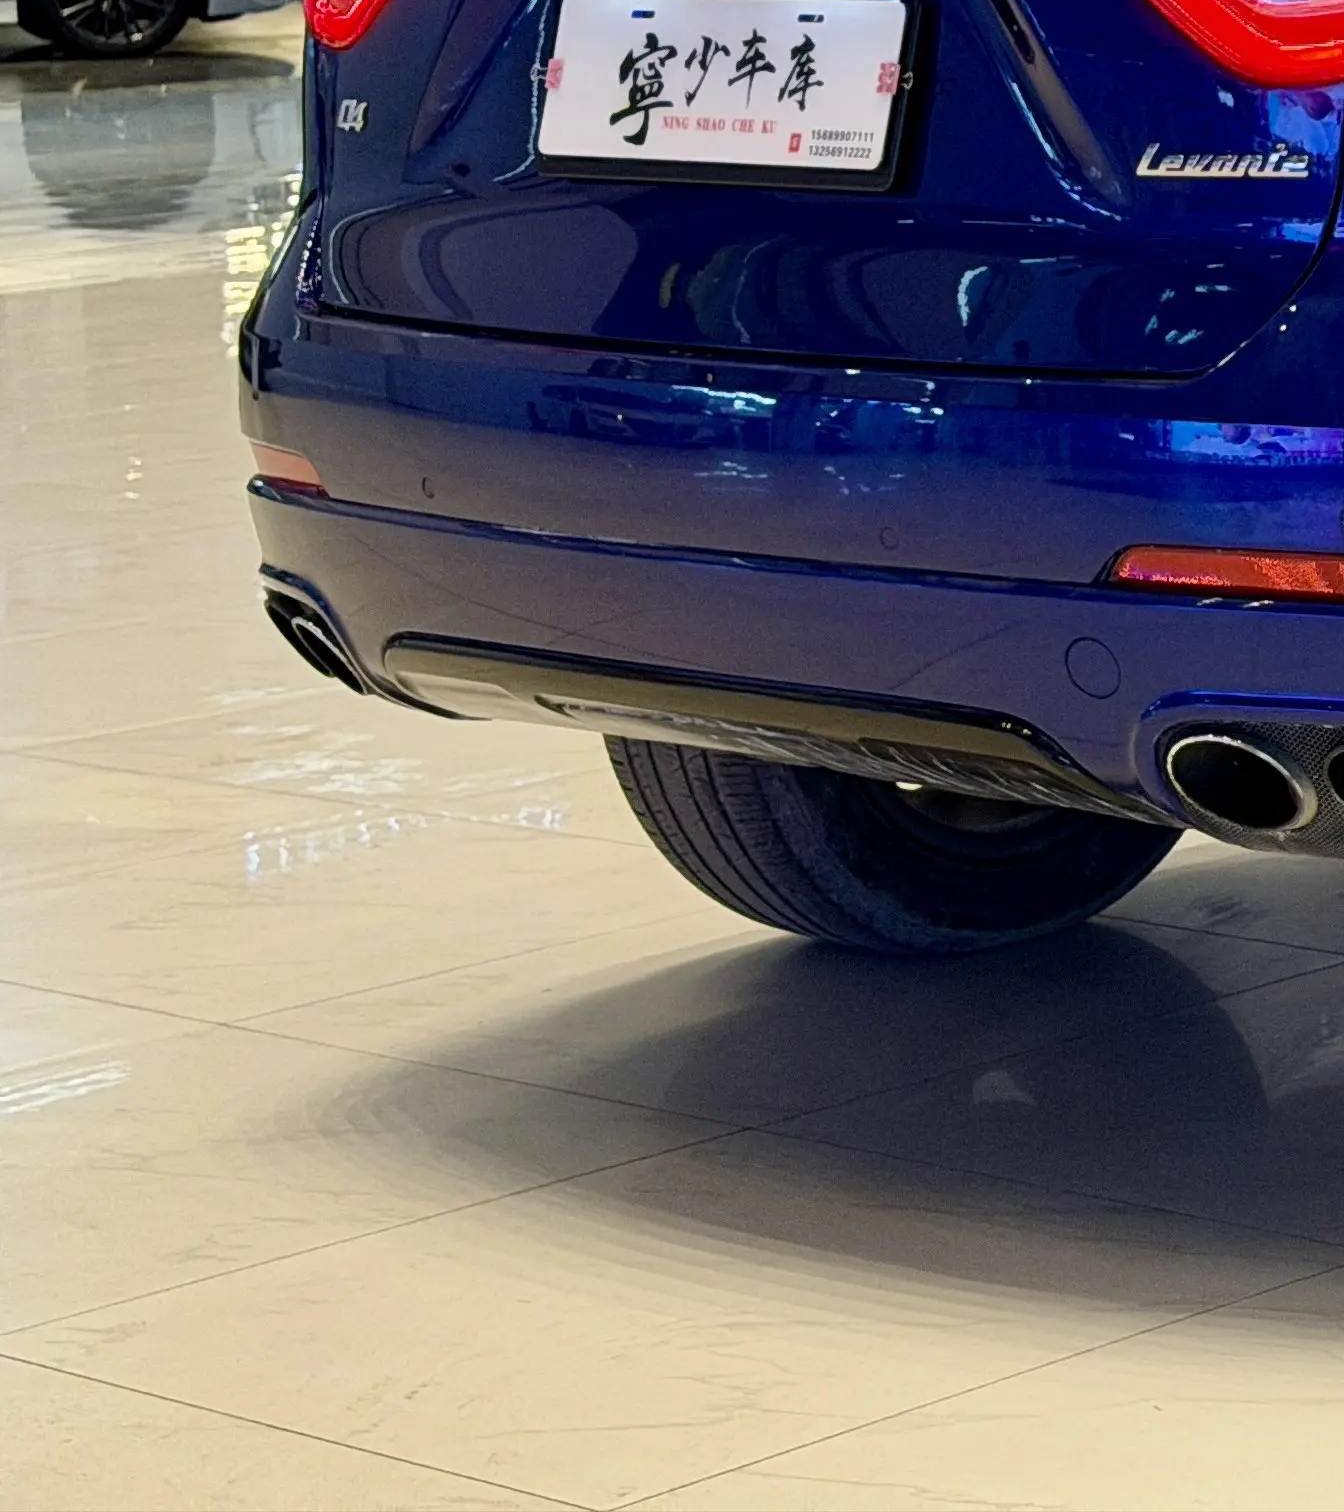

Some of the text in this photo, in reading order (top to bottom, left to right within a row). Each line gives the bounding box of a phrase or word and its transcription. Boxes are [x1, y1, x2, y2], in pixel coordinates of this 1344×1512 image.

[661, 116, 778, 134] NING SHAO CHE KU
[1136, 143, 1309, 177] Levante
